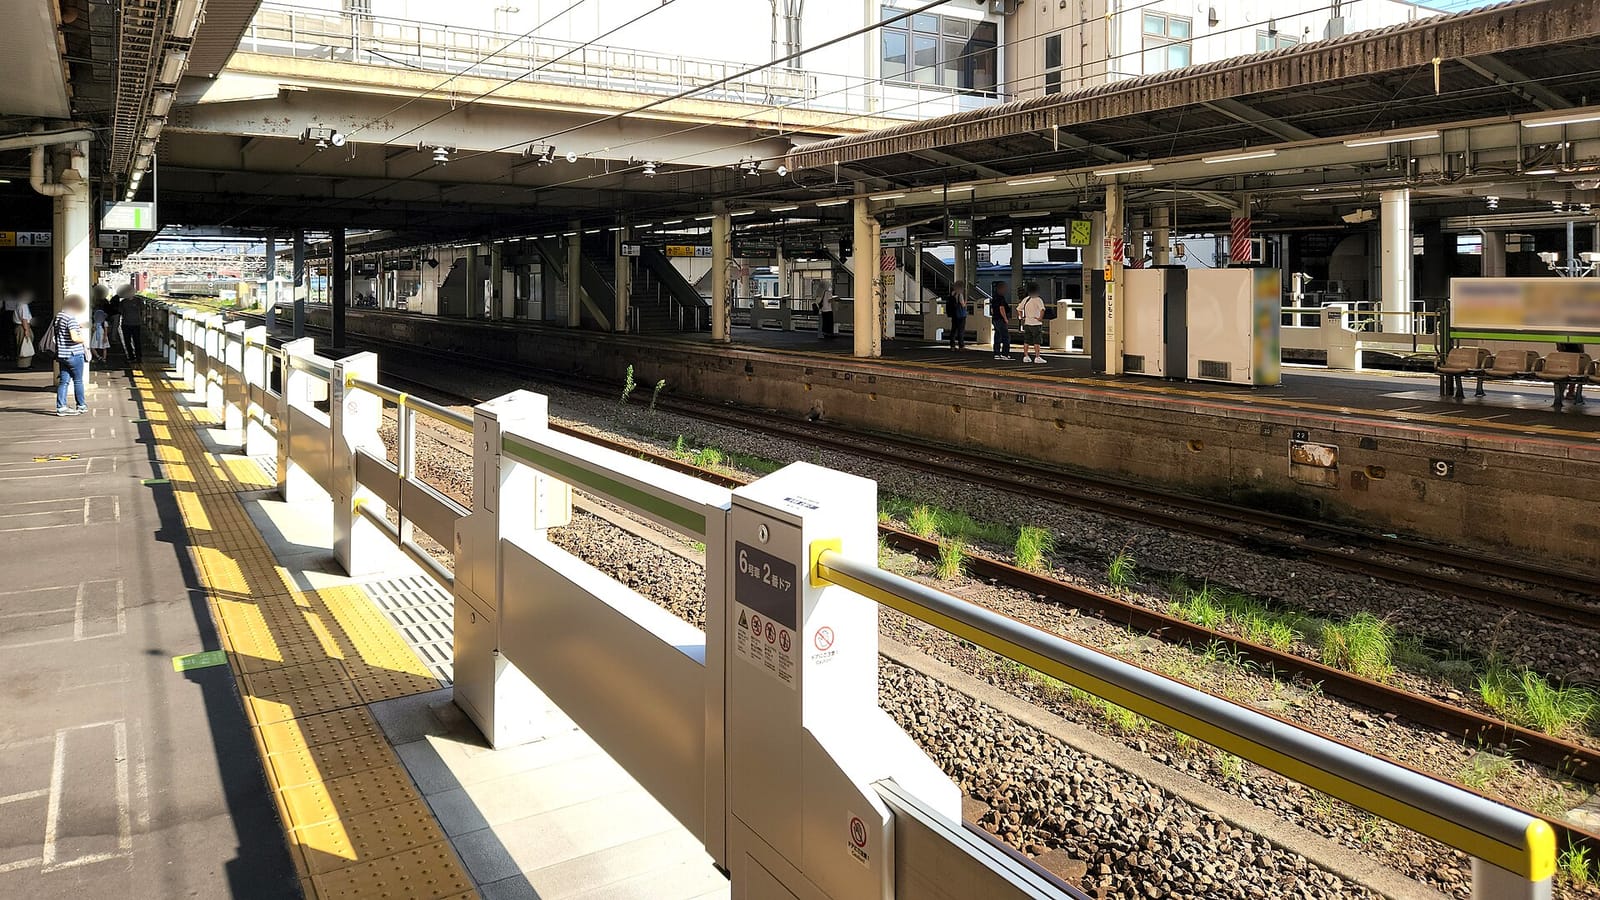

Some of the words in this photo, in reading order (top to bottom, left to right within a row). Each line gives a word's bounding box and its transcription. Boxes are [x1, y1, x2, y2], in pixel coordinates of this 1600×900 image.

[949, 219, 955, 229] 2
[1436, 461, 1448, 476] 9
[763, 562, 792, 592] 2番ドア
